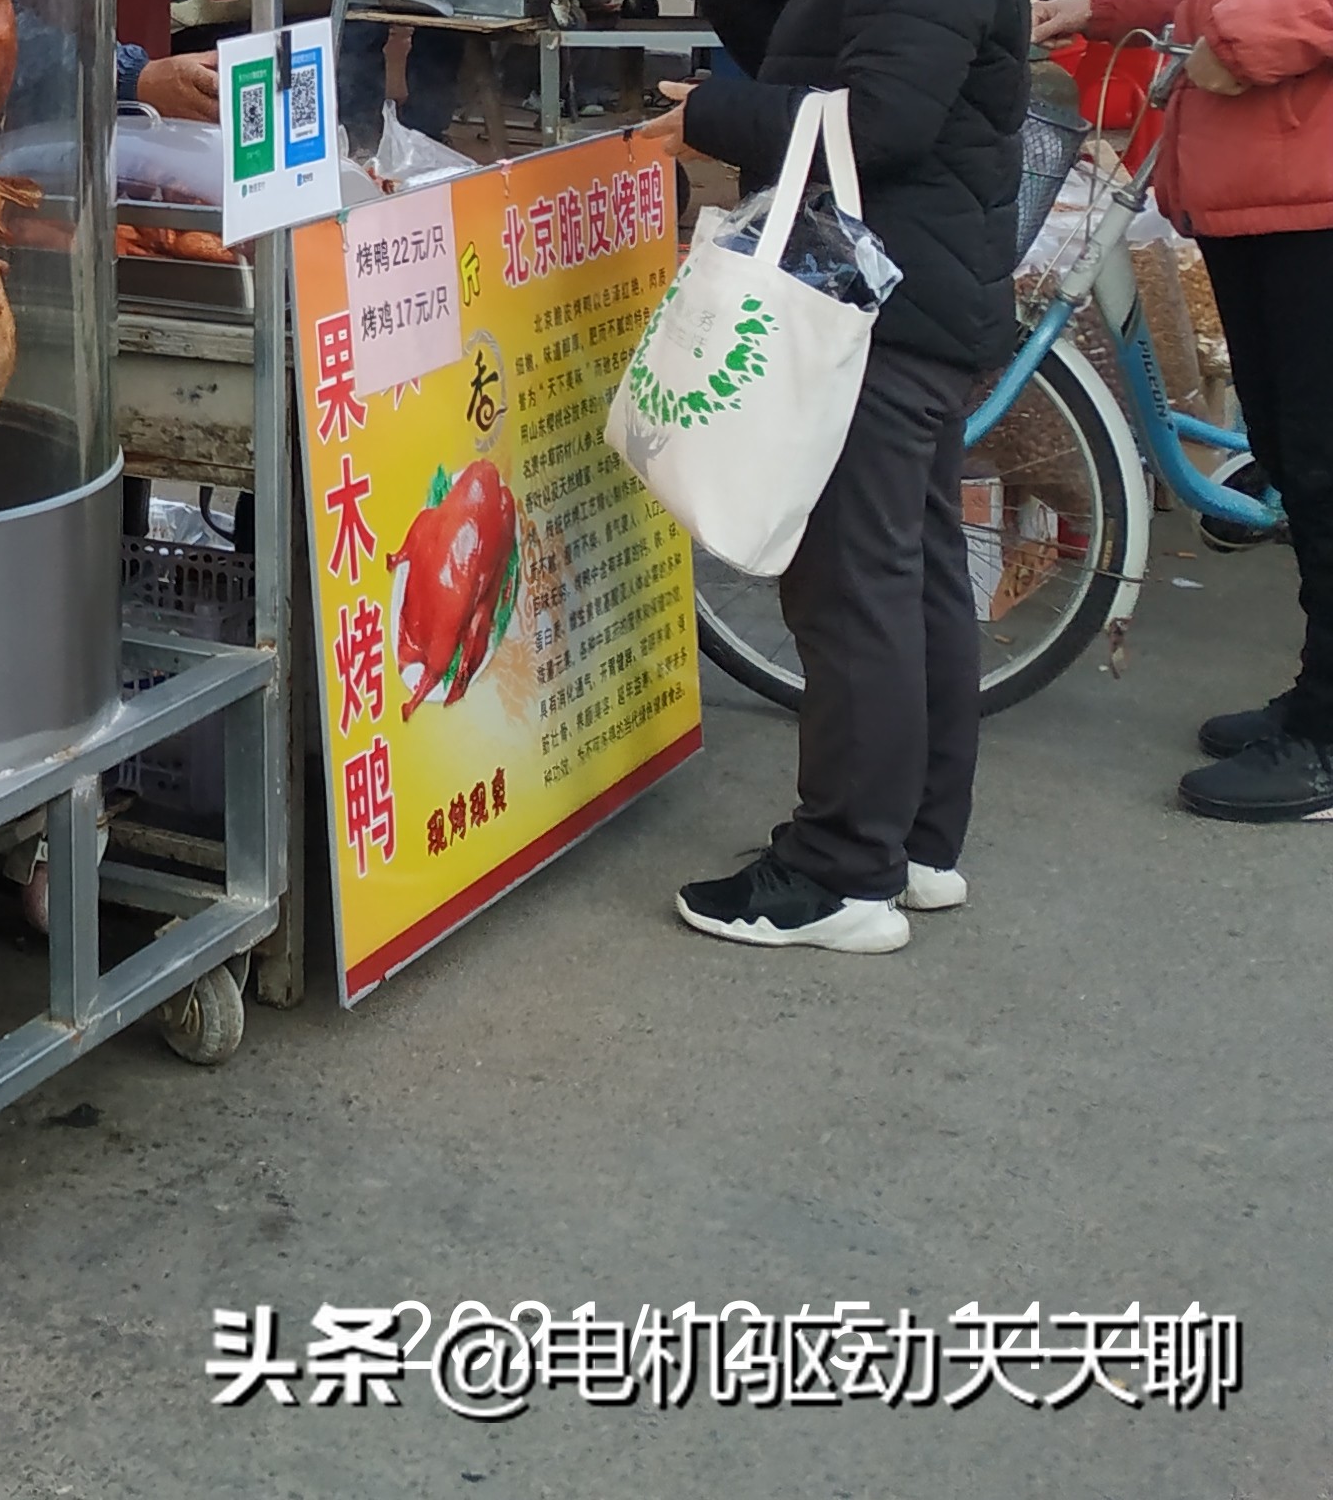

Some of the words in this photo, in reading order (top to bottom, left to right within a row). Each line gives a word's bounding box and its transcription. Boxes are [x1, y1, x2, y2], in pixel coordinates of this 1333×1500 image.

[356, 226, 447, 278] 烤鸭22元/只
[502, 162, 665, 288] 北京脆皮烤鸭
[459, 243, 481, 307] 斤
[361, 286, 451, 342] 烤鸡17元/只
[314, 311, 398, 879] 果木烤鸭
